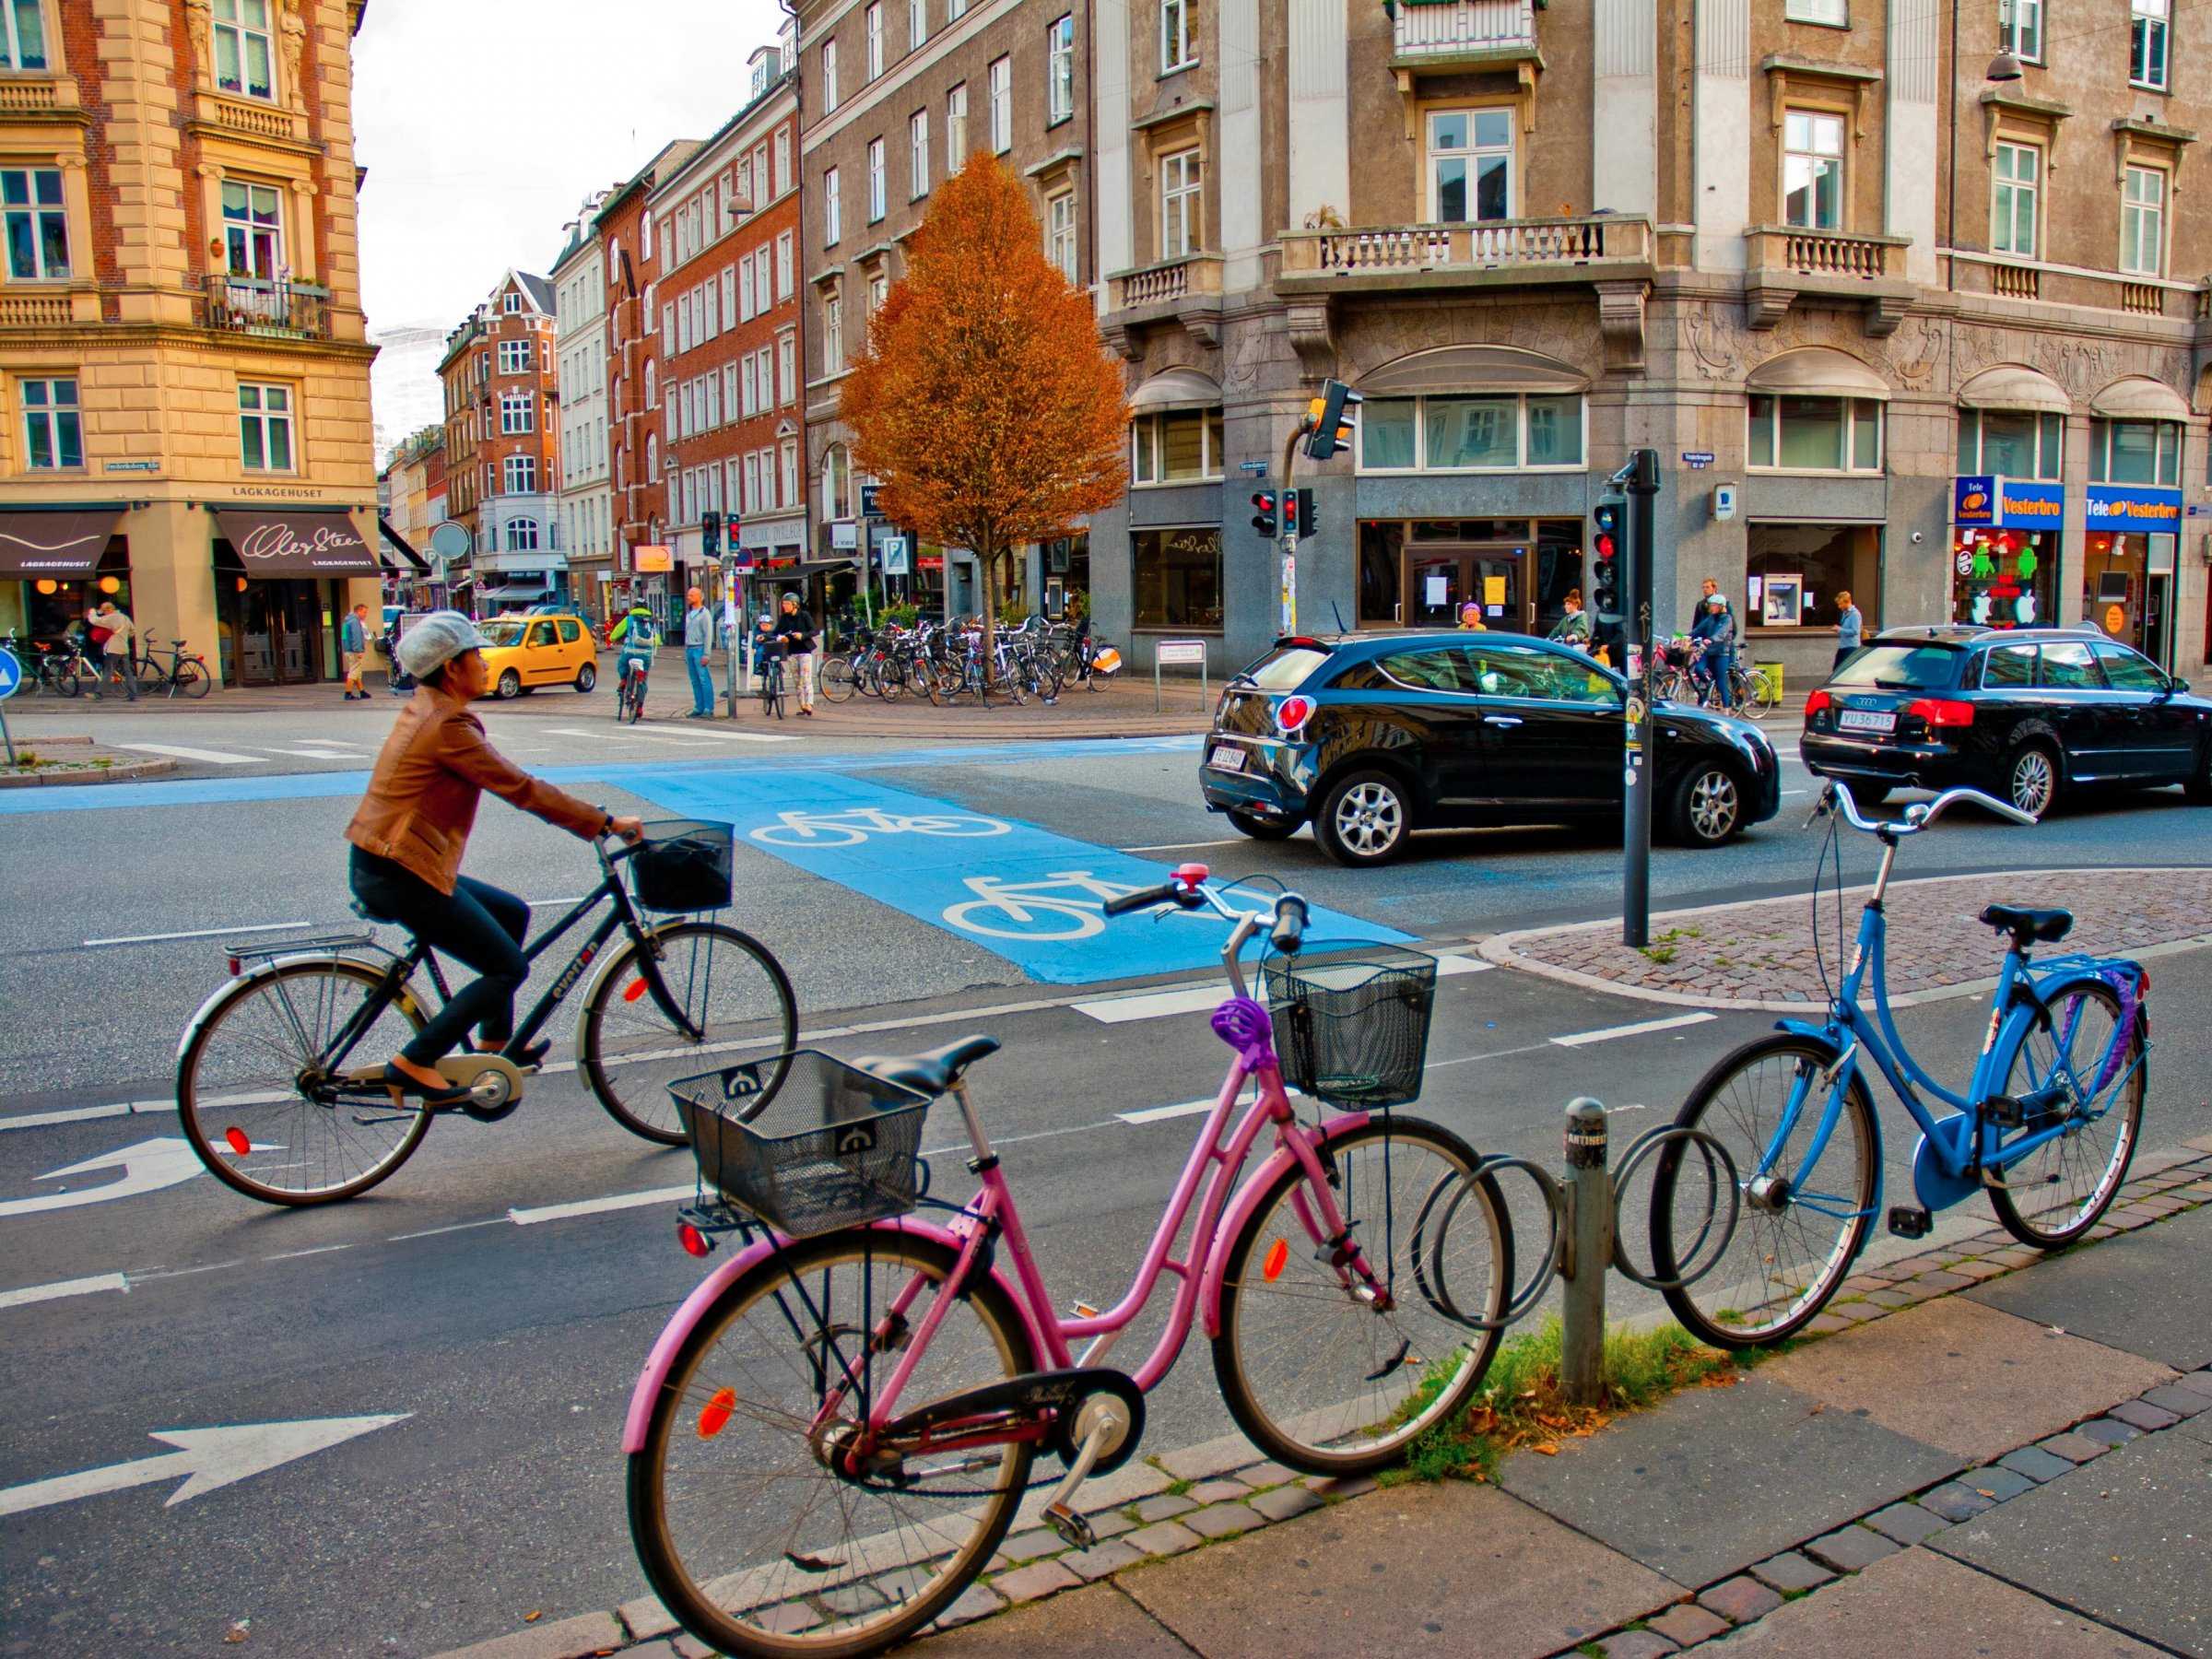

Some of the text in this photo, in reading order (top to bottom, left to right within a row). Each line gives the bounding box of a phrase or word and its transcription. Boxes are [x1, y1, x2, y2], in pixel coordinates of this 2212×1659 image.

[232, 487, 323, 498] LAGKAGEHUSET
[1968, 482, 1983, 492] Tele
[2002, 496, 2061, 516] Vesterbro
[2086, 499, 2179, 520] Tele Vesterbro
[1959, 510, 1992, 519] Vesterbro
[552, 941, 598, 999] everton
